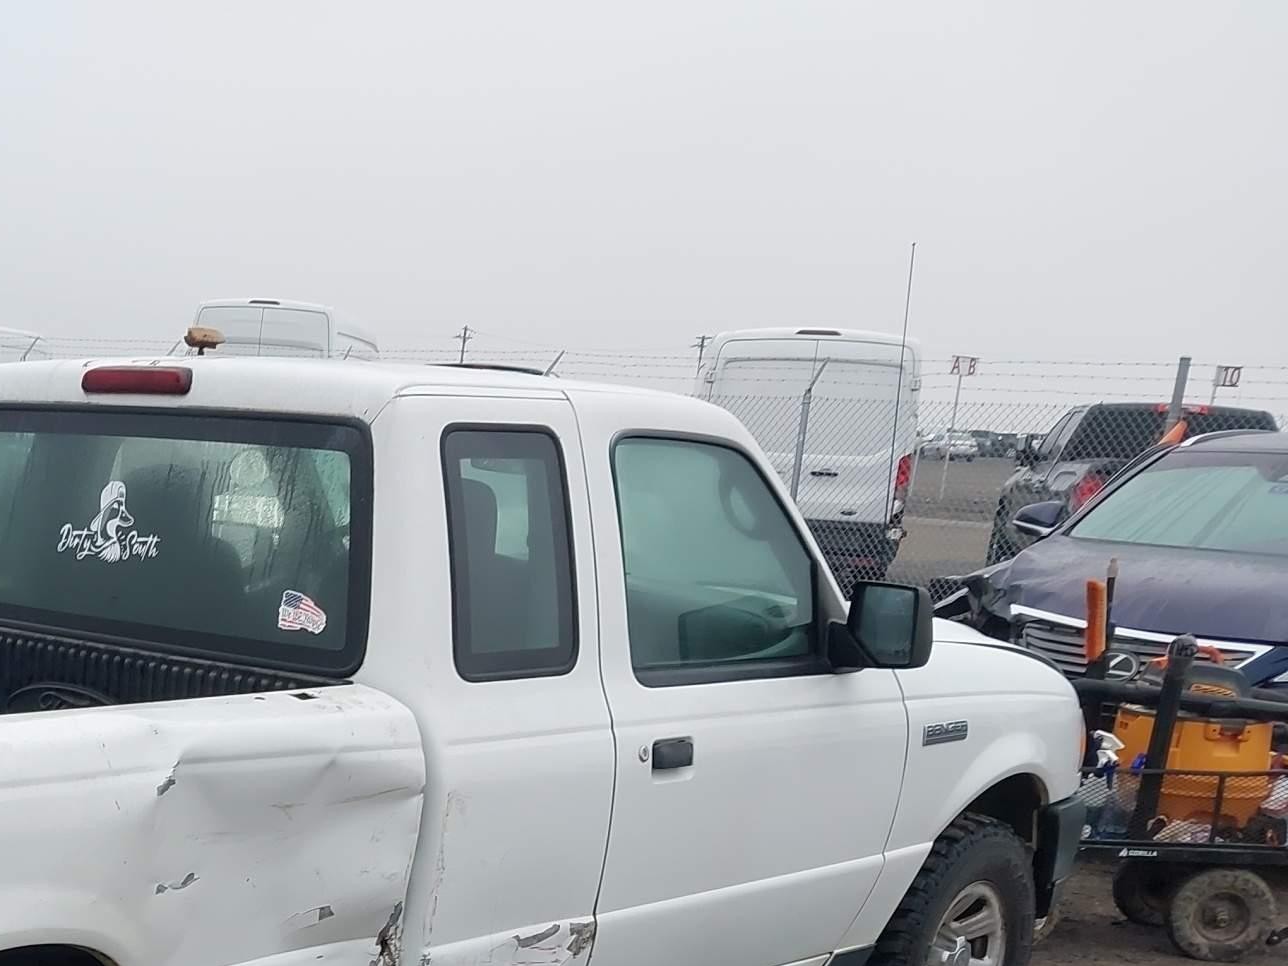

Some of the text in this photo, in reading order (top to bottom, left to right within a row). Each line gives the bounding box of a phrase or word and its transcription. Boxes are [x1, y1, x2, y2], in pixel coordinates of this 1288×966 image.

[950, 355, 977, 376] A B
[1222, 366, 1241, 386] 10
[57, 523, 161, 561] Dirty South
